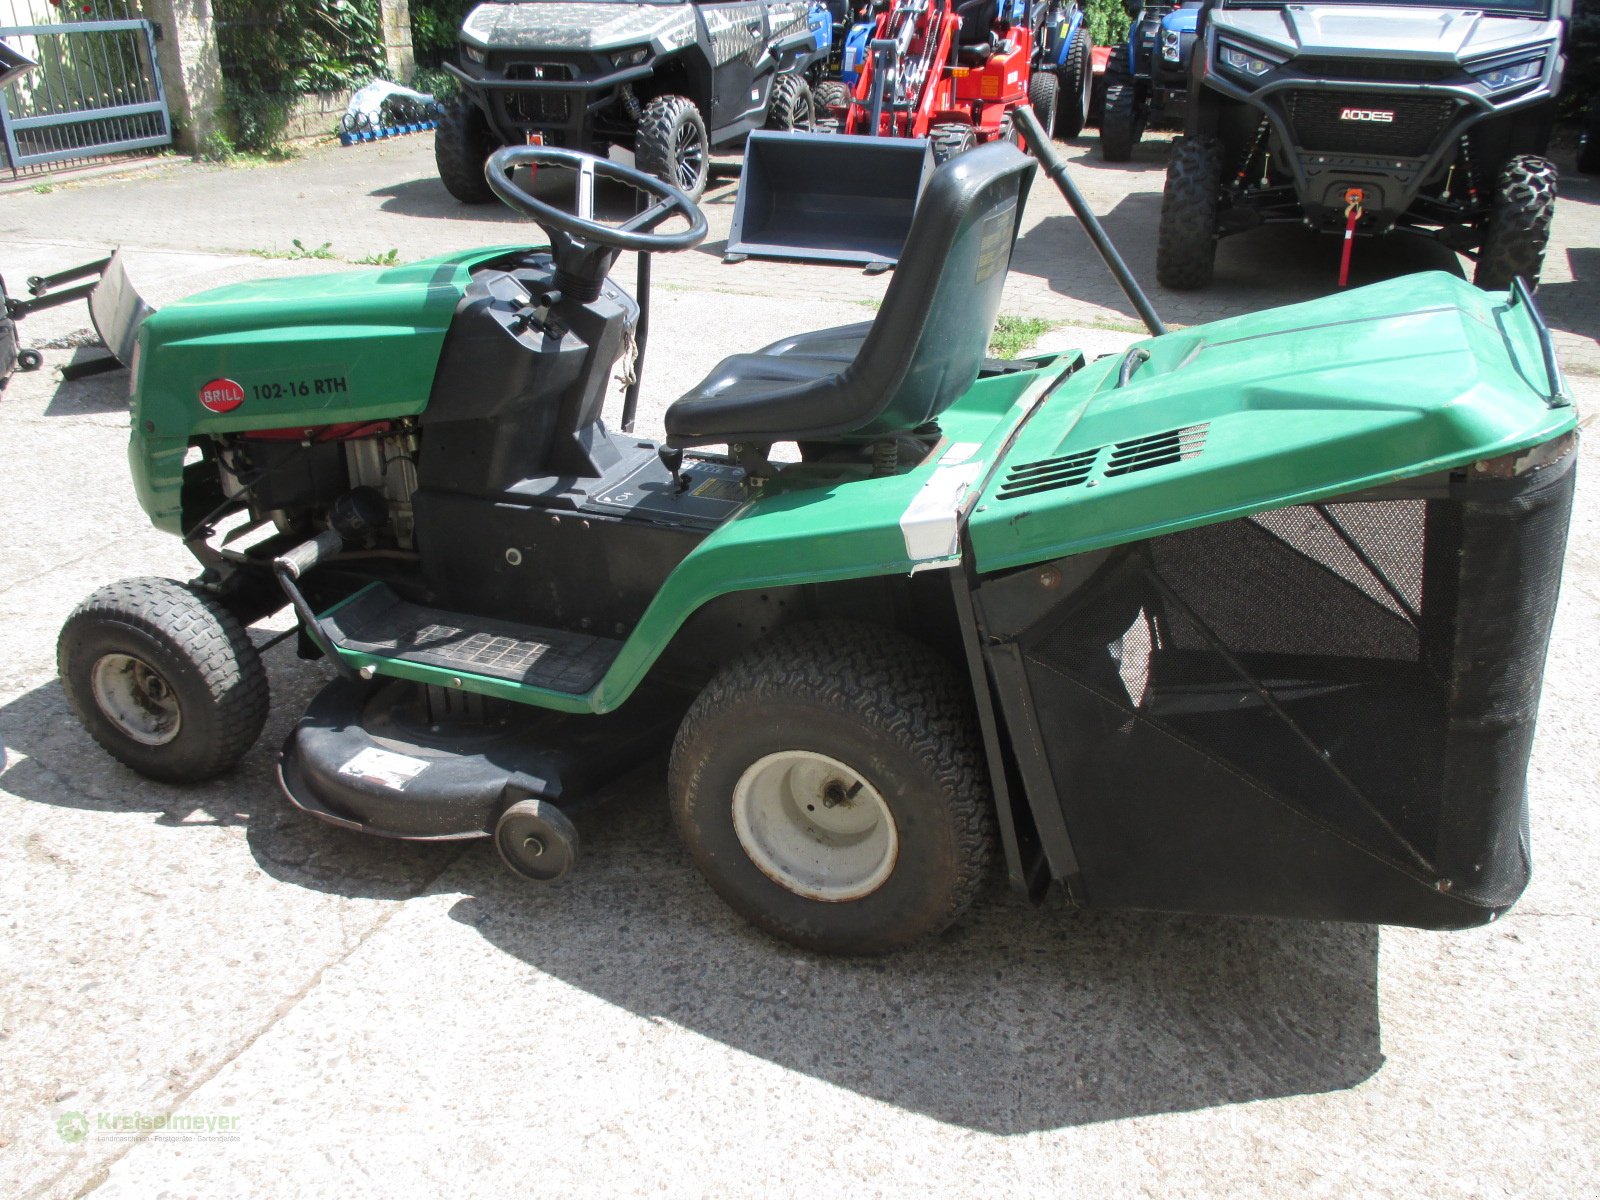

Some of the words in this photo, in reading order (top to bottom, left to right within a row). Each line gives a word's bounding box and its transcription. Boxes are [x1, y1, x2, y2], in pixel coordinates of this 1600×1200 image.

[1341, 109, 1394, 123] AODES
[204, 388, 241, 403] BRILL
[253, 382, 309, 400] 102-16
[314, 377, 347, 395] RTH
